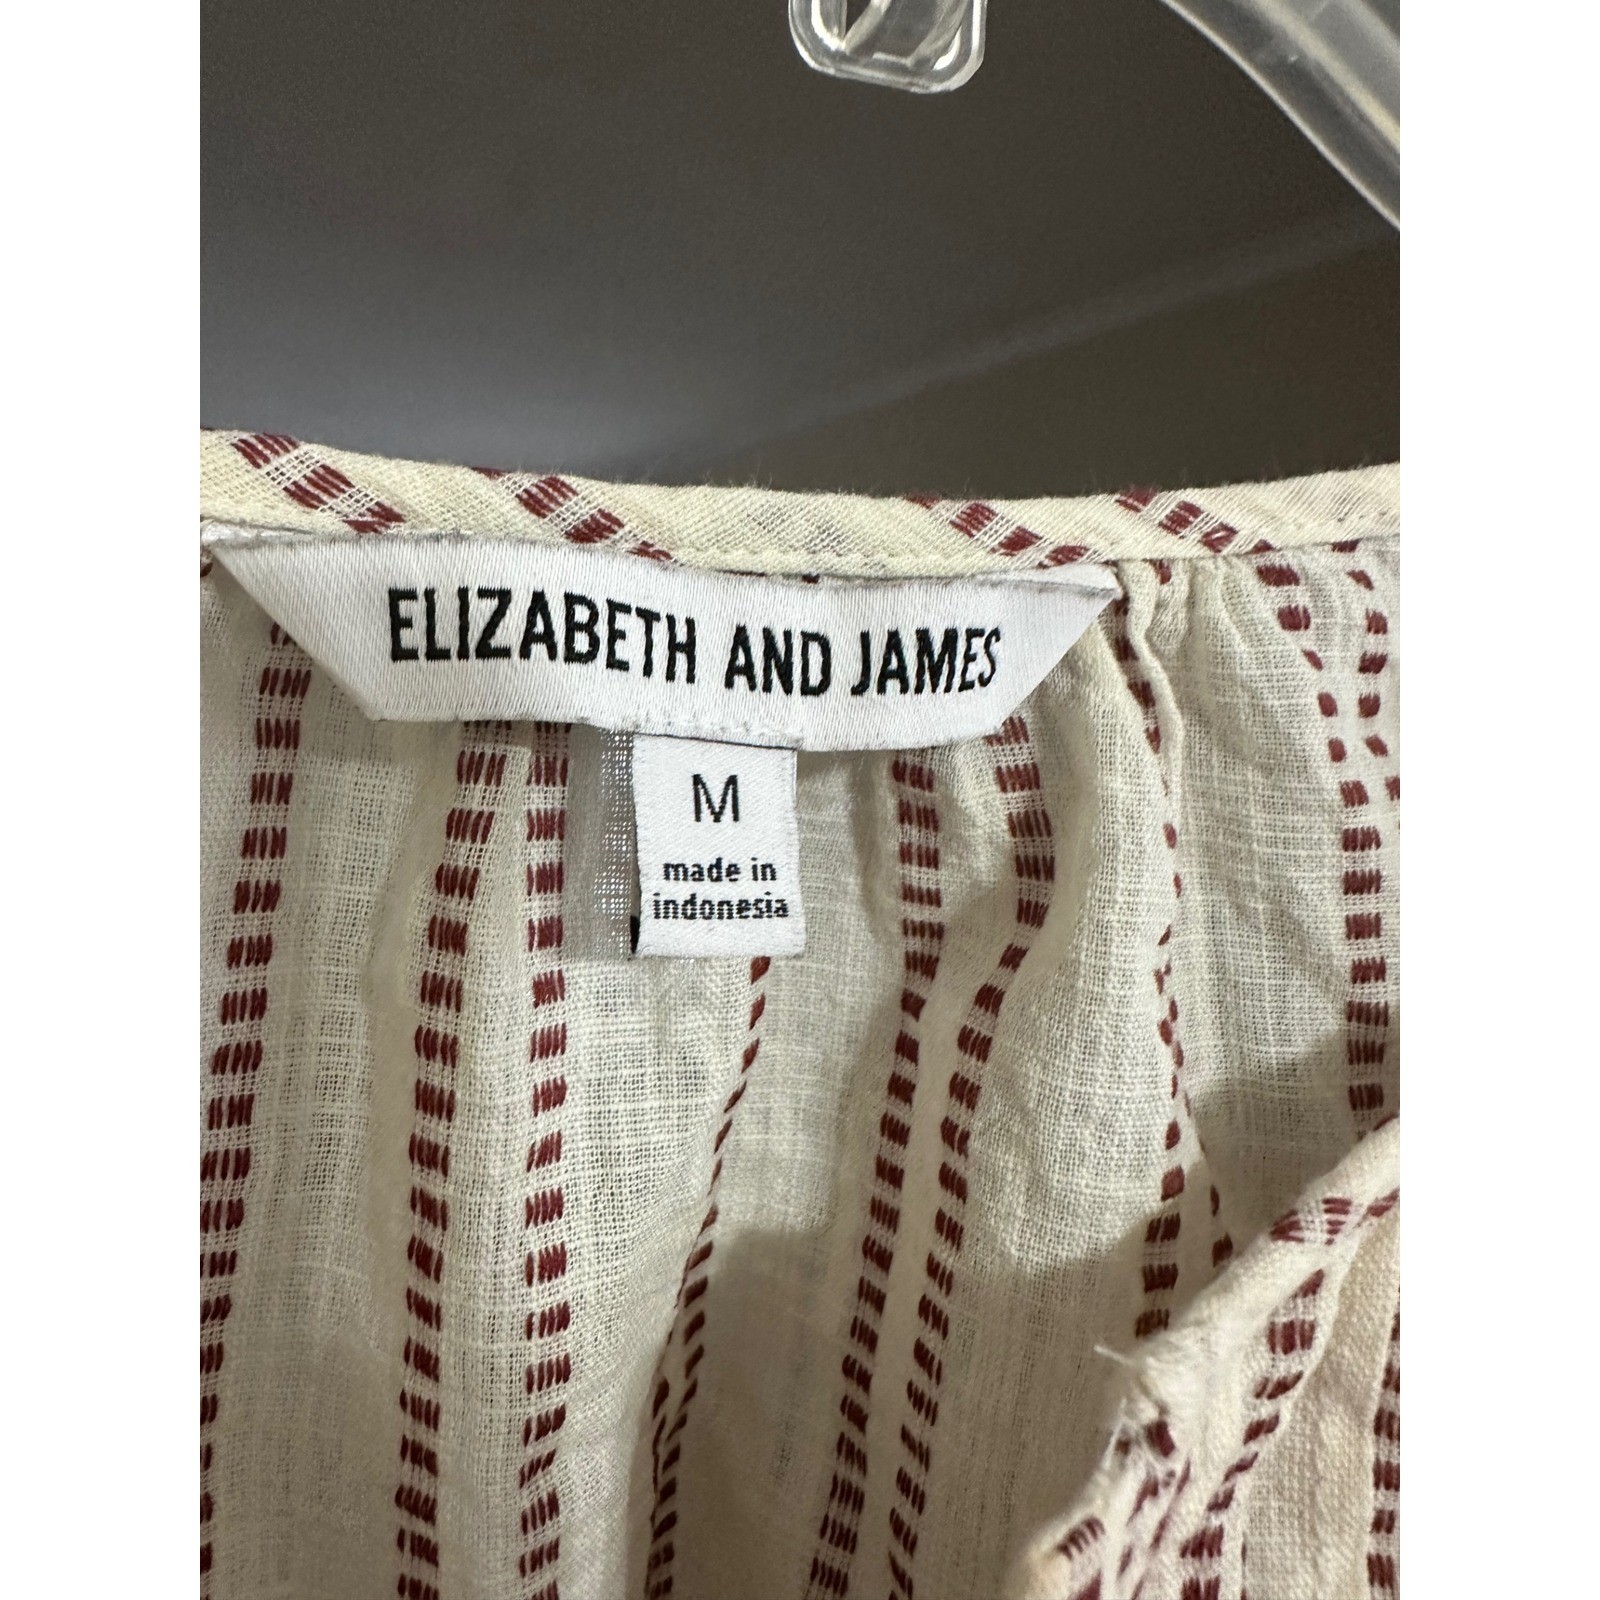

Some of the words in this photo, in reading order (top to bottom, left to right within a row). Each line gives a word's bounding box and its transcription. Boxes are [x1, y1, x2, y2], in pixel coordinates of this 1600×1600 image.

[388, 585, 698, 685] ELIZABETH
[724, 624, 833, 698] AND
[849, 626, 1001, 697] JAMES
[691, 773, 740, 823] M
[662, 856, 742, 883] made
[750, 857, 778, 882] in
[652, 891, 790, 921] indonesia
